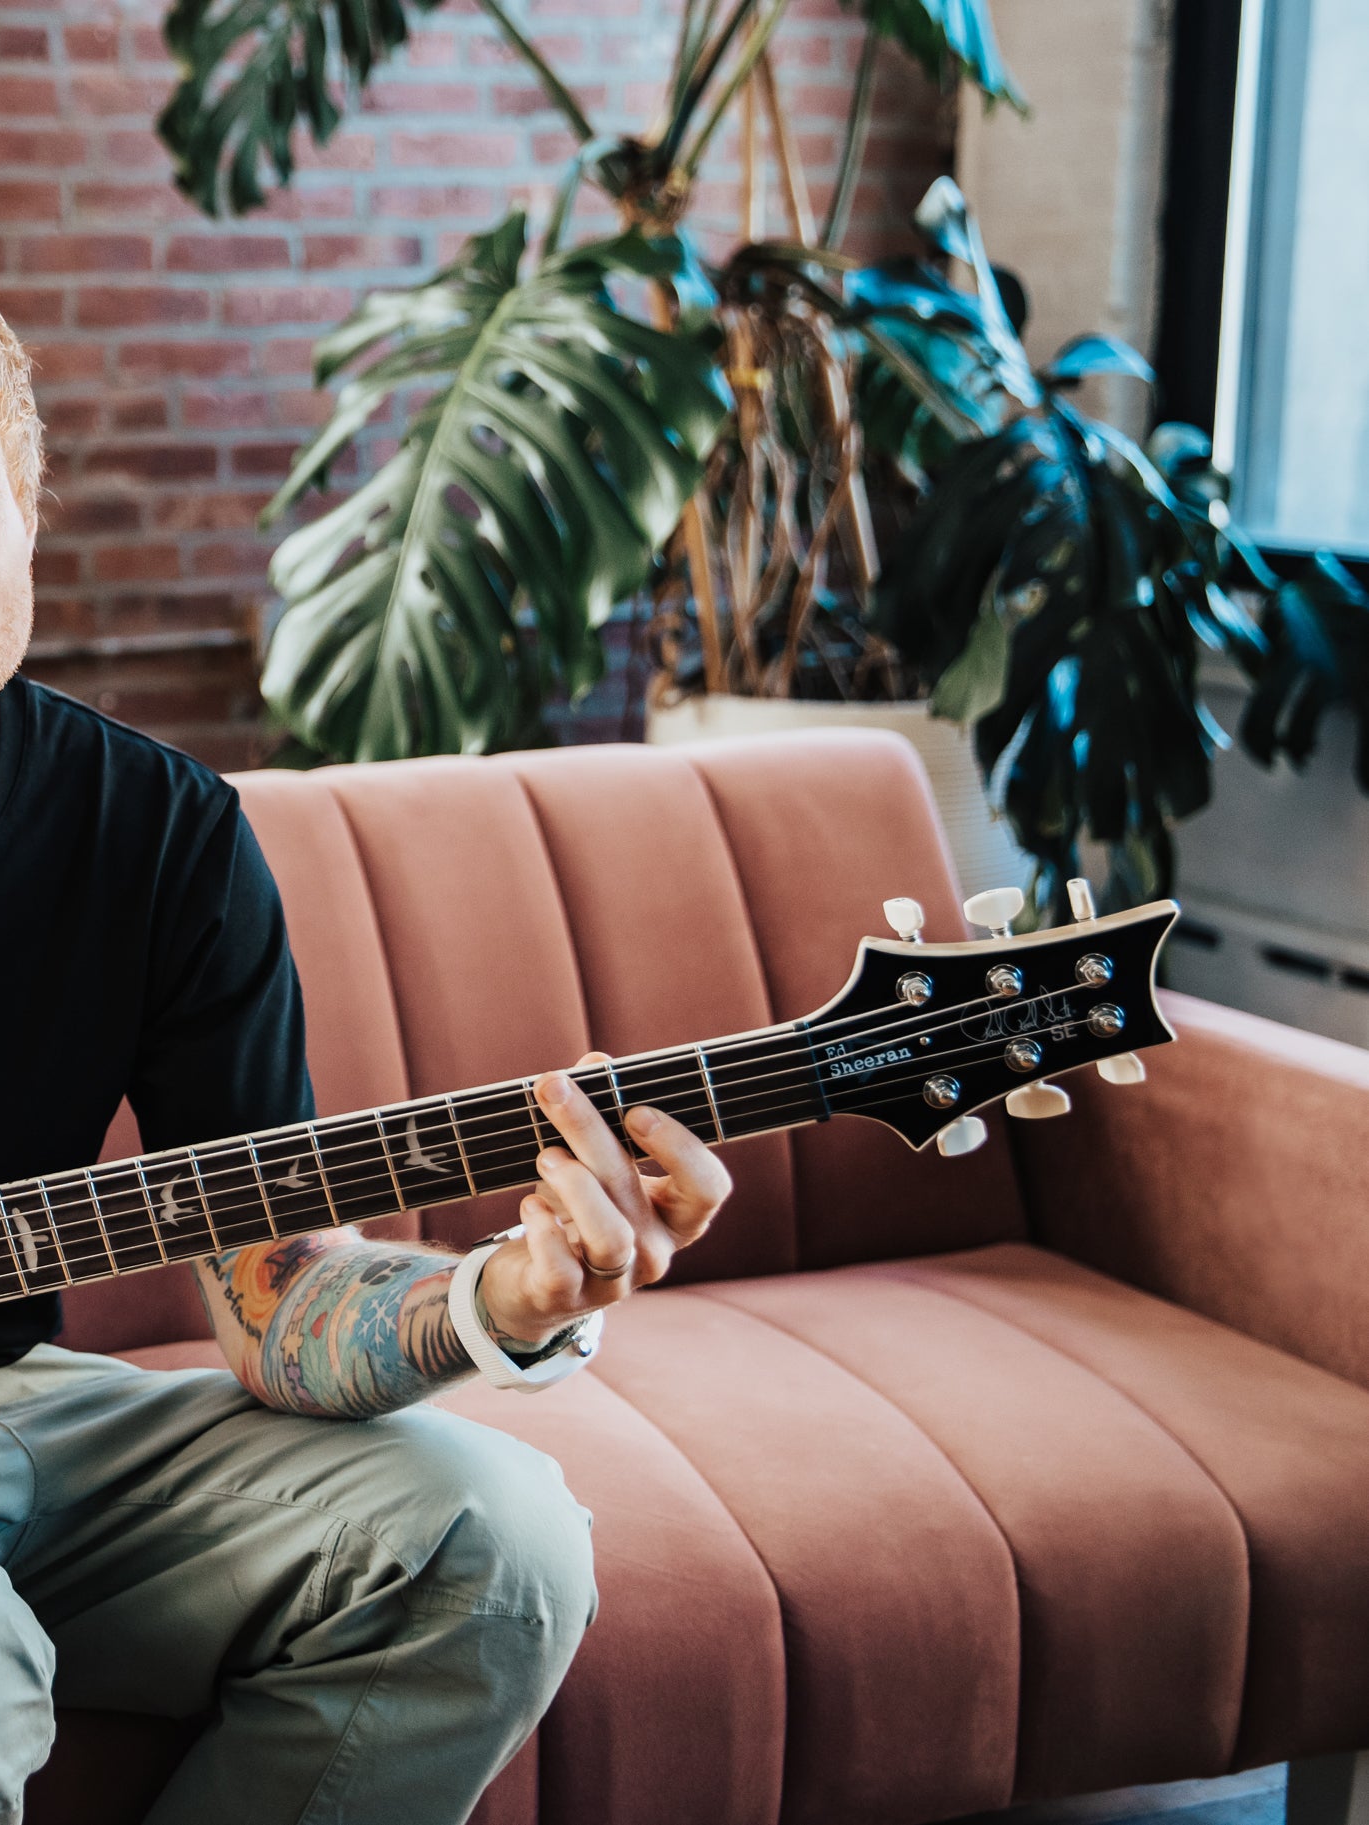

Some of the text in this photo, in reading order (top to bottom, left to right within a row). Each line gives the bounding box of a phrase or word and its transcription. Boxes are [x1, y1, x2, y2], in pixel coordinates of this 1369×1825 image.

[1050, 1020, 1078, 1042] SE
[825, 1043, 847, 1060] Ed
[829, 1047, 912, 1078] Sheeran
